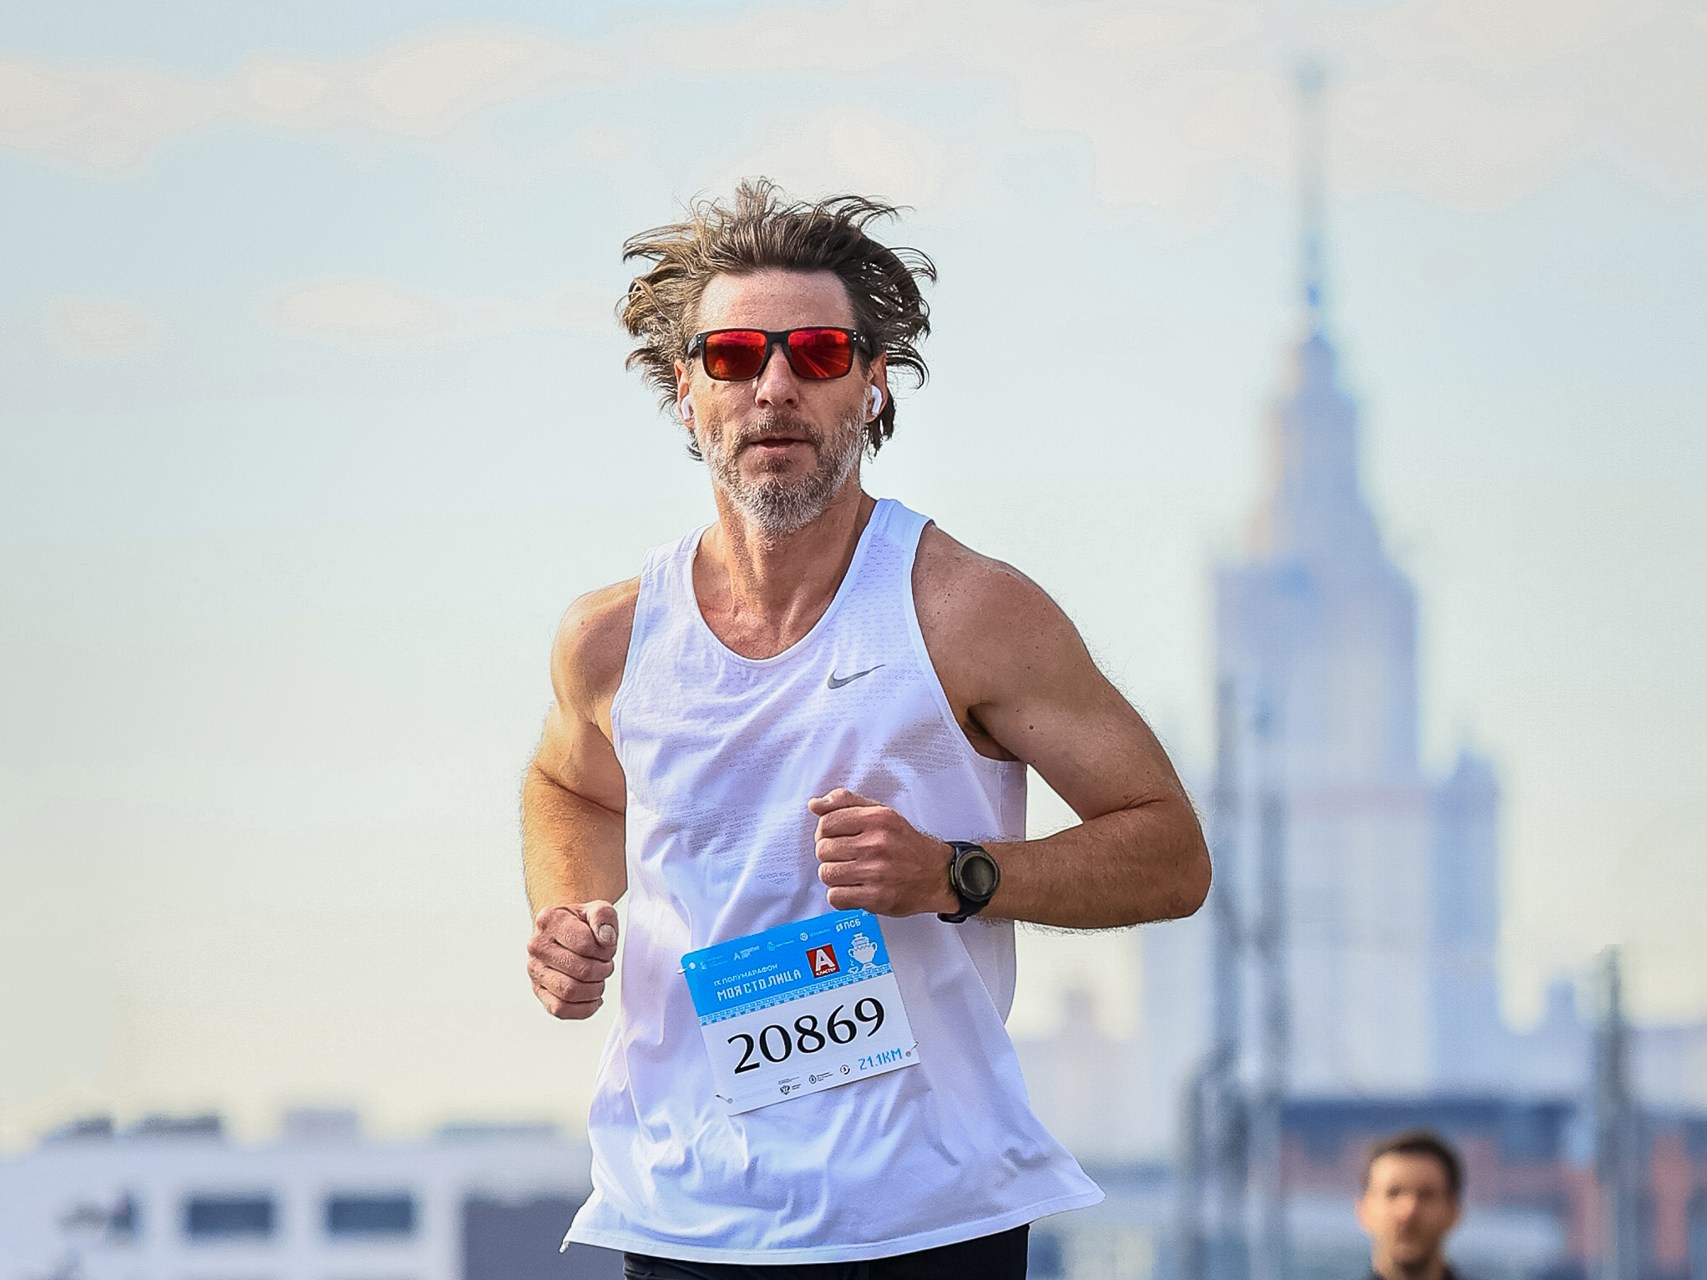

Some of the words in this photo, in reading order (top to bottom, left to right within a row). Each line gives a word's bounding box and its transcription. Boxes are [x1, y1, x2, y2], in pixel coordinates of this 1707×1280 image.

[722, 963, 778, 985] ПОЛУМАРАФОН
[815, 948, 835, 972] А
[717, 985, 742, 1002] МОЯ
[743, 969, 802, 994] СТОЛИЦА
[727, 997, 885, 1075] 20869
